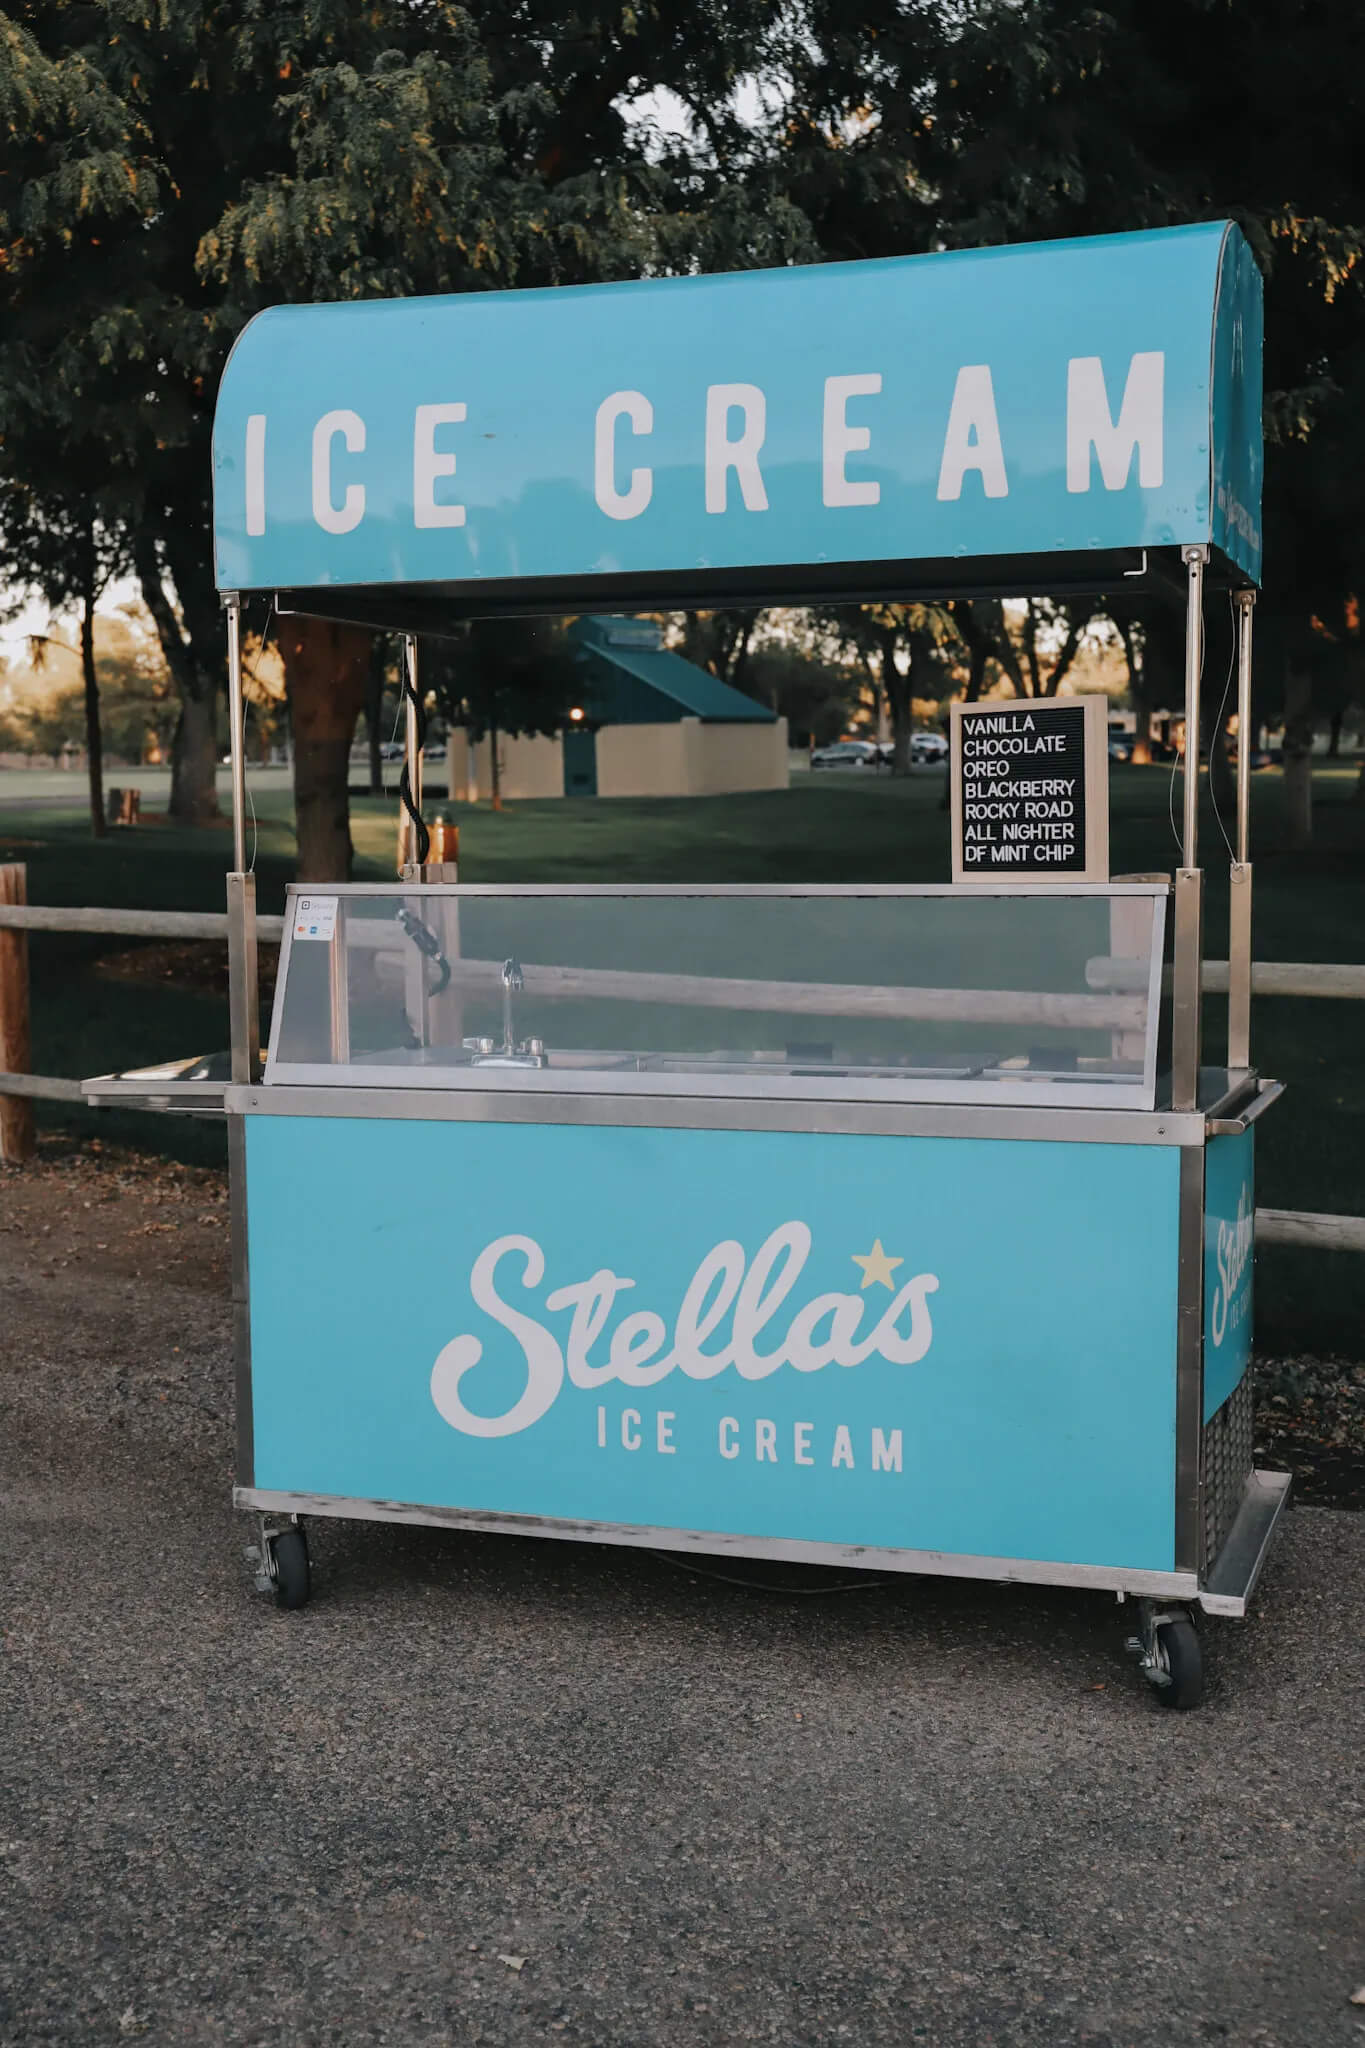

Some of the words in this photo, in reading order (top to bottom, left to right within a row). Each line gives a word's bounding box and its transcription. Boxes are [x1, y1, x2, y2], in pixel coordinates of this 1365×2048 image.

[246, 403, 466, 537] ICE
[594, 351, 1165, 521] CREAM
[963, 714, 1036, 736] VANILLA
[963, 734, 1067, 757] CHOCOLATE
[963, 759, 1010, 778] OREO
[965, 778, 1076, 800] BLACKBERRY
[965, 802, 1021, 820] ROCKY
[1024, 800, 1074, 819] ROAD
[965, 823, 997, 842] ALL
[1002, 822, 1075, 841] NIGHTER
[965, 845, 988, 863] DF
[991, 844, 1030, 863] MINT
[1033, 843, 1075, 862] CHIP
[598, 1406, 676, 1454] ICE
[718, 1416, 903, 1473] CREAM
